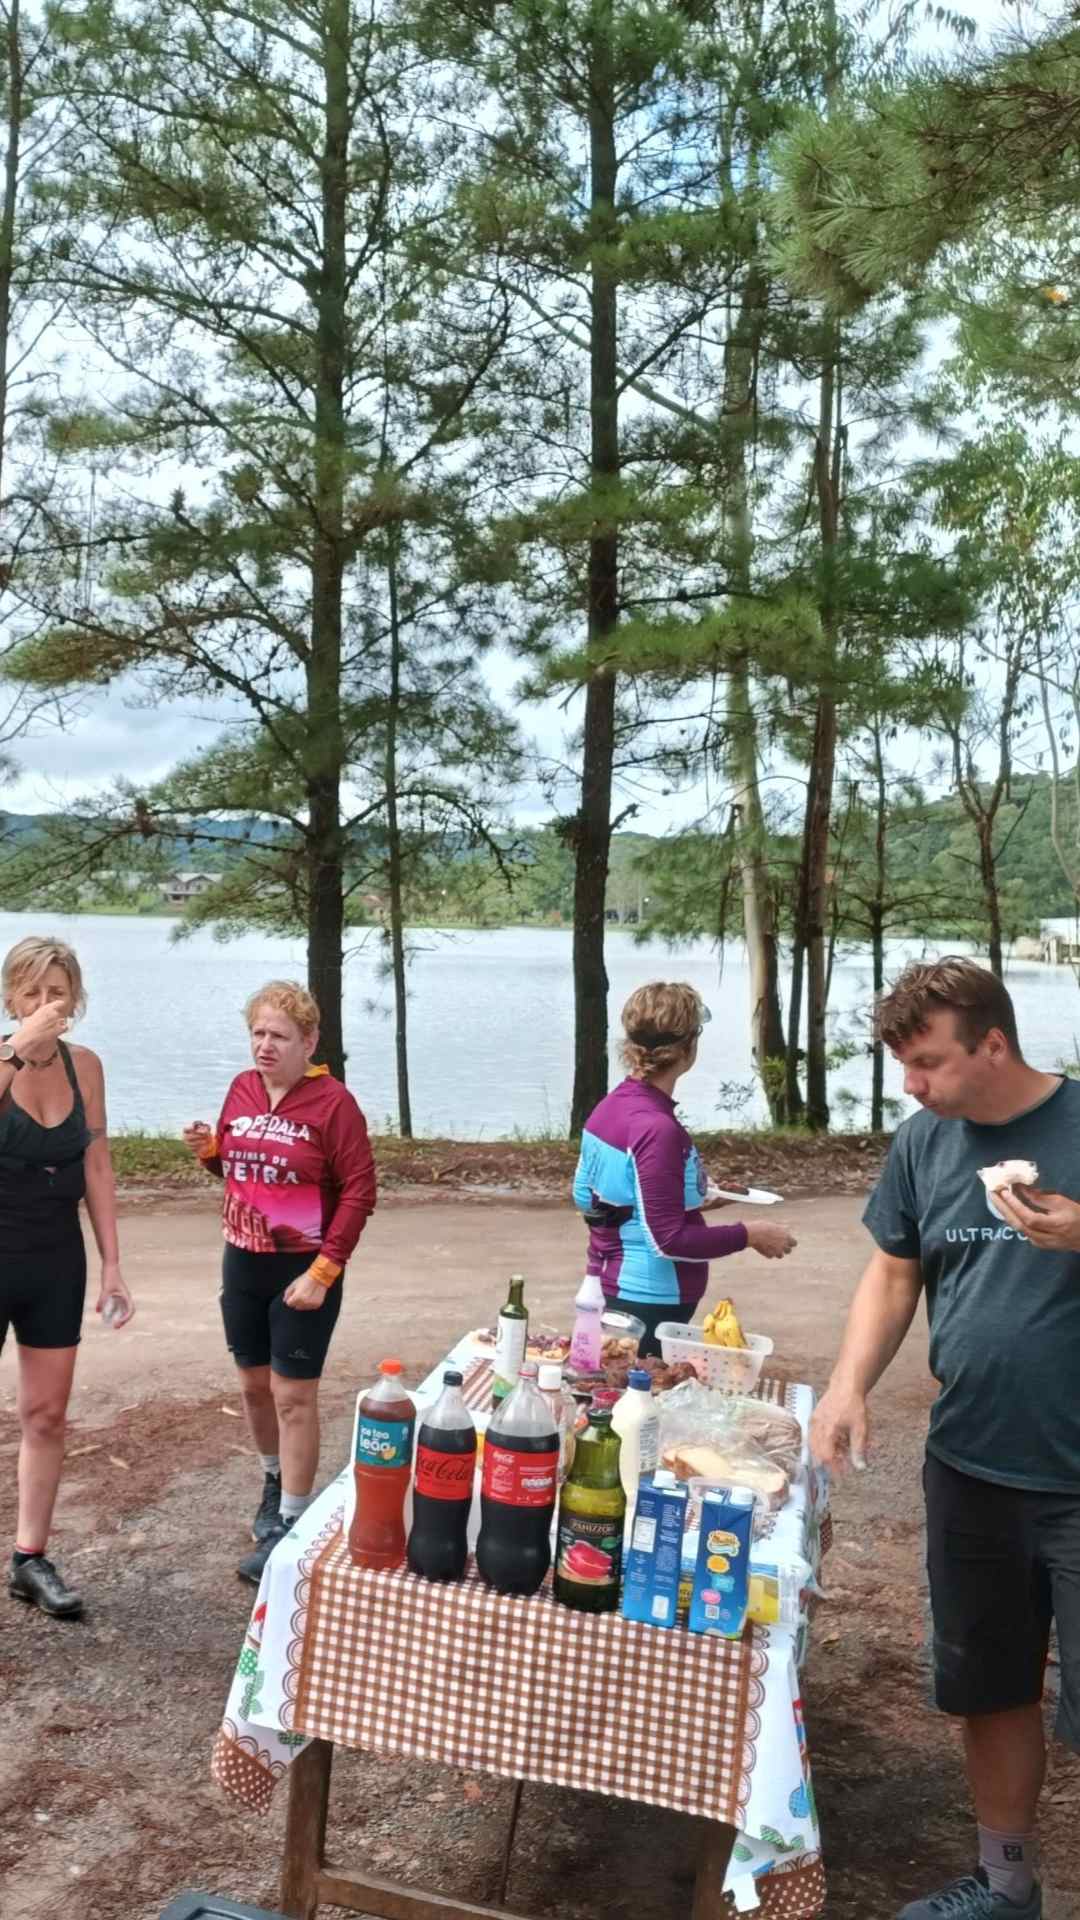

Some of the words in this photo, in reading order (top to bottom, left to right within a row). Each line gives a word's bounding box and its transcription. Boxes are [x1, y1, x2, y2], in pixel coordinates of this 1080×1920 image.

[251, 1113, 310, 1141] PEDALA
[222, 1160, 299, 1184] PETRA
[272, 1155, 289, 1167] DE
